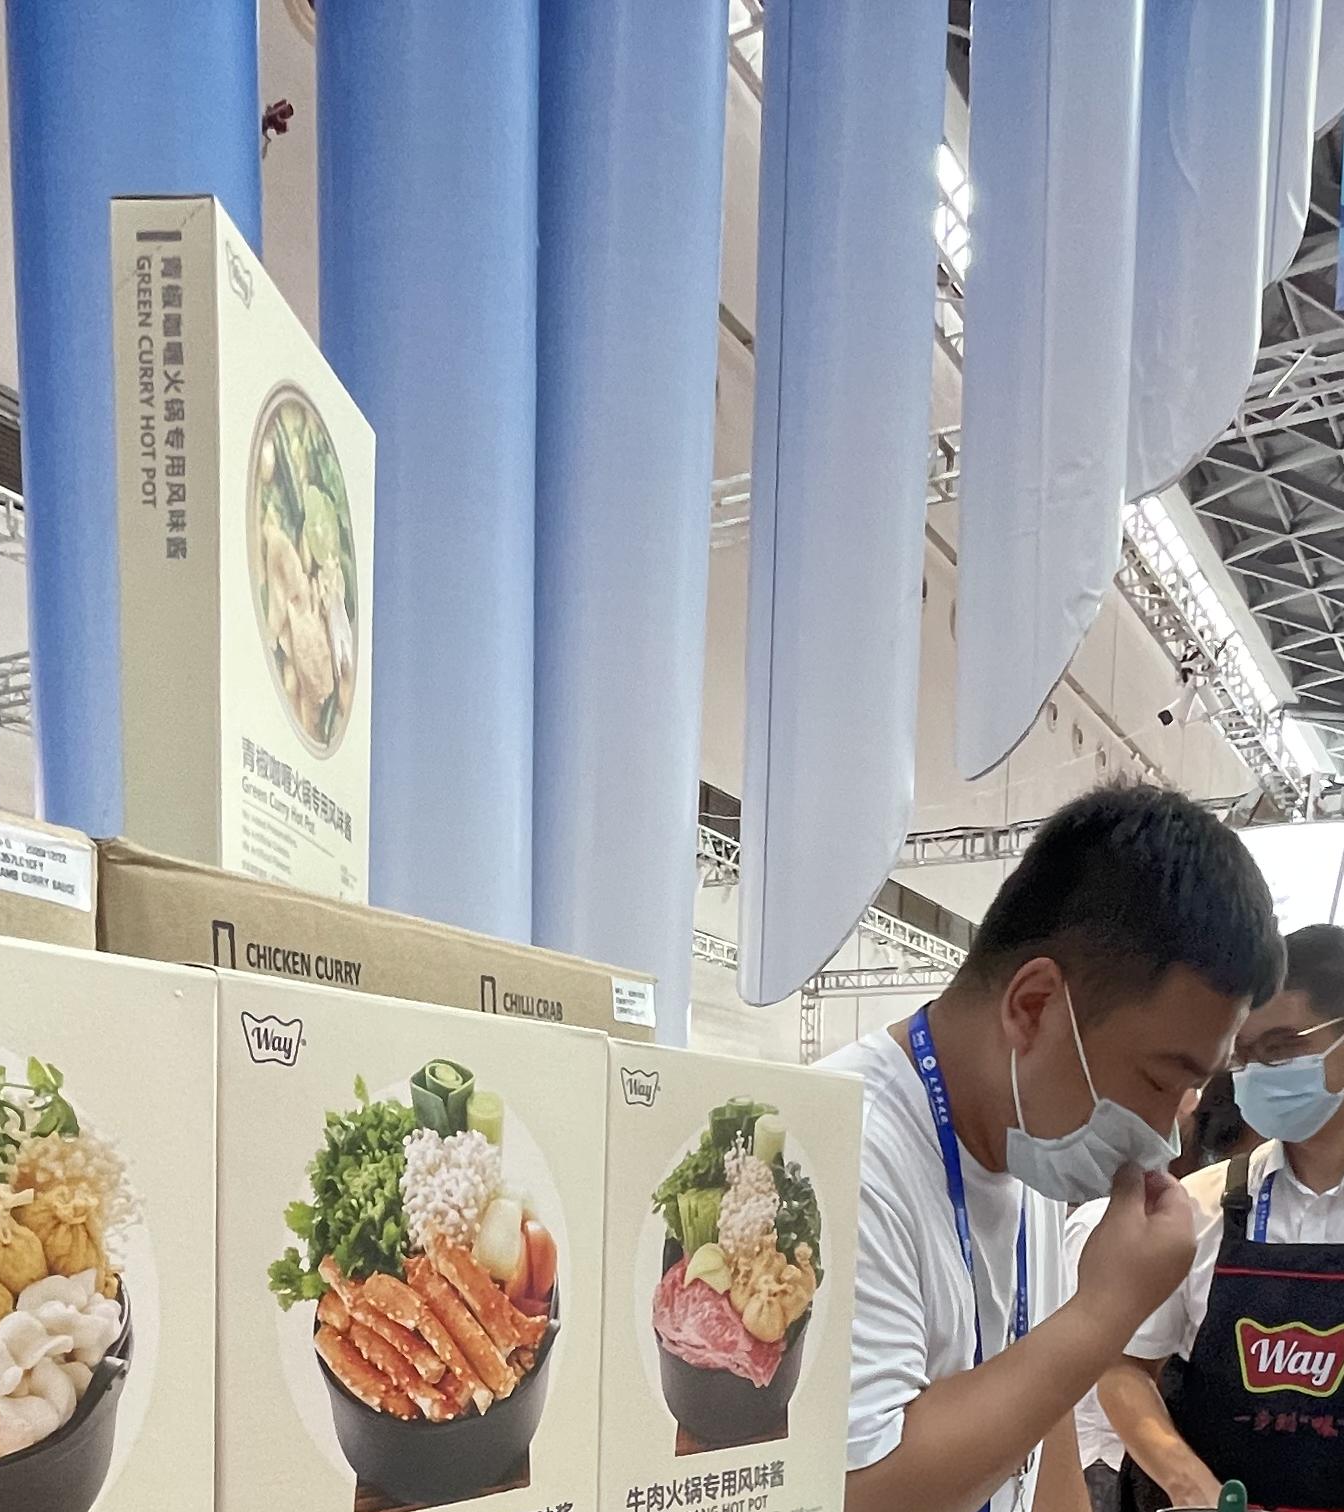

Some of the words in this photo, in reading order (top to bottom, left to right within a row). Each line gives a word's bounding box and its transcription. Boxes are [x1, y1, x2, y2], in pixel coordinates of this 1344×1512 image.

[136, 254, 154, 329] GREEN
[138, 335, 156, 410] CURRY
[140, 414, 157, 461] HOT
[142, 467, 157, 509] POT
[242, 775, 268, 803] Green
[269, 791, 291, 822] Curry
[245, 942, 311, 980] CHICKEN
[314, 953, 362, 987] CURRY
[502, 990, 535, 1019] CHILLI
[537, 997, 564, 1022] CRAB
[252, 1026, 293, 1060] Way
[625, 1077, 654, 1098] Way
[1250, 1338, 1336, 1387] Way
[748, 1494, 769, 1511] POT
